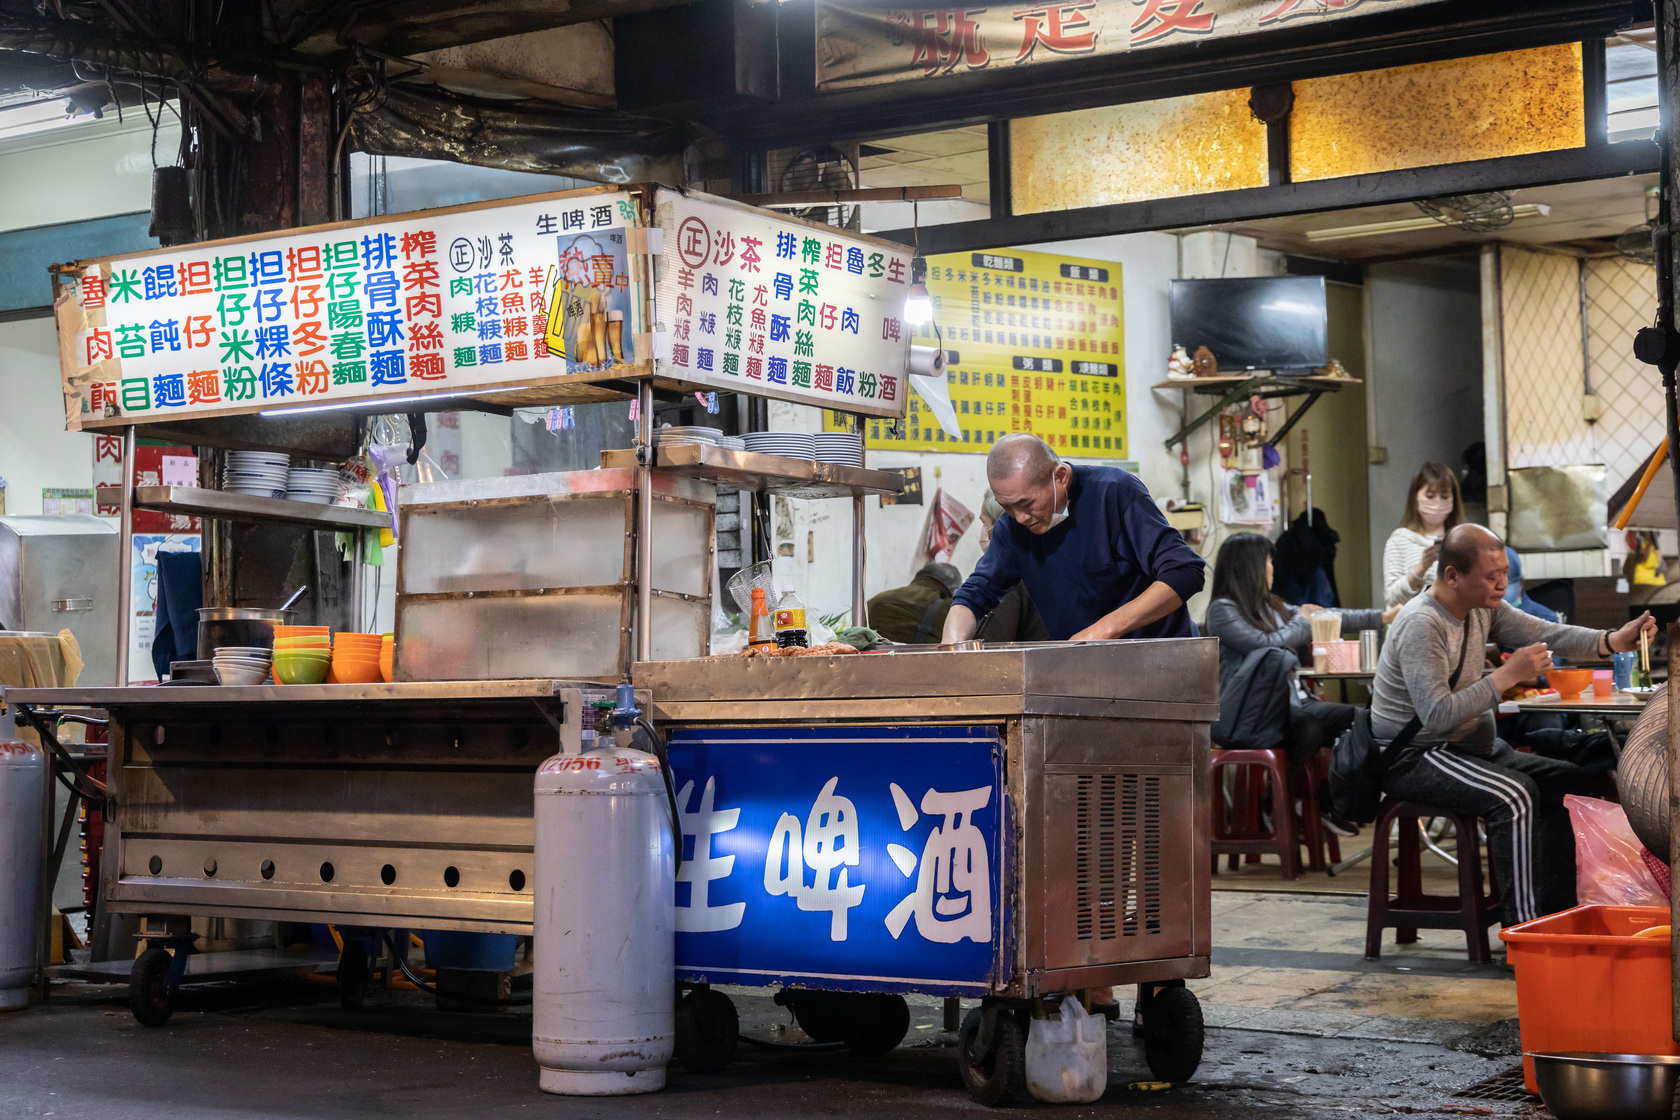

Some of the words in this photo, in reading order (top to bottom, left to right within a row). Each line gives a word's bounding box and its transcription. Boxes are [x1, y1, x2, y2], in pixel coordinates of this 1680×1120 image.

[536, 204, 613, 235] 生啤酒
[558, 246, 630, 293] 熱賣中
[110, 269, 150, 411] 米苔目
[142, 264, 186, 408] 餛飩麵
[360, 232, 407, 387] 排骨酥麵
[767, 231, 797, 385] 排骨酥麵
[835, 246, 865, 395] 魯肉飯
[858, 252, 886, 400] 冬粉
[877, 257, 906, 402] 生啤酒
[675, 774, 993, 943] 生啤酒
